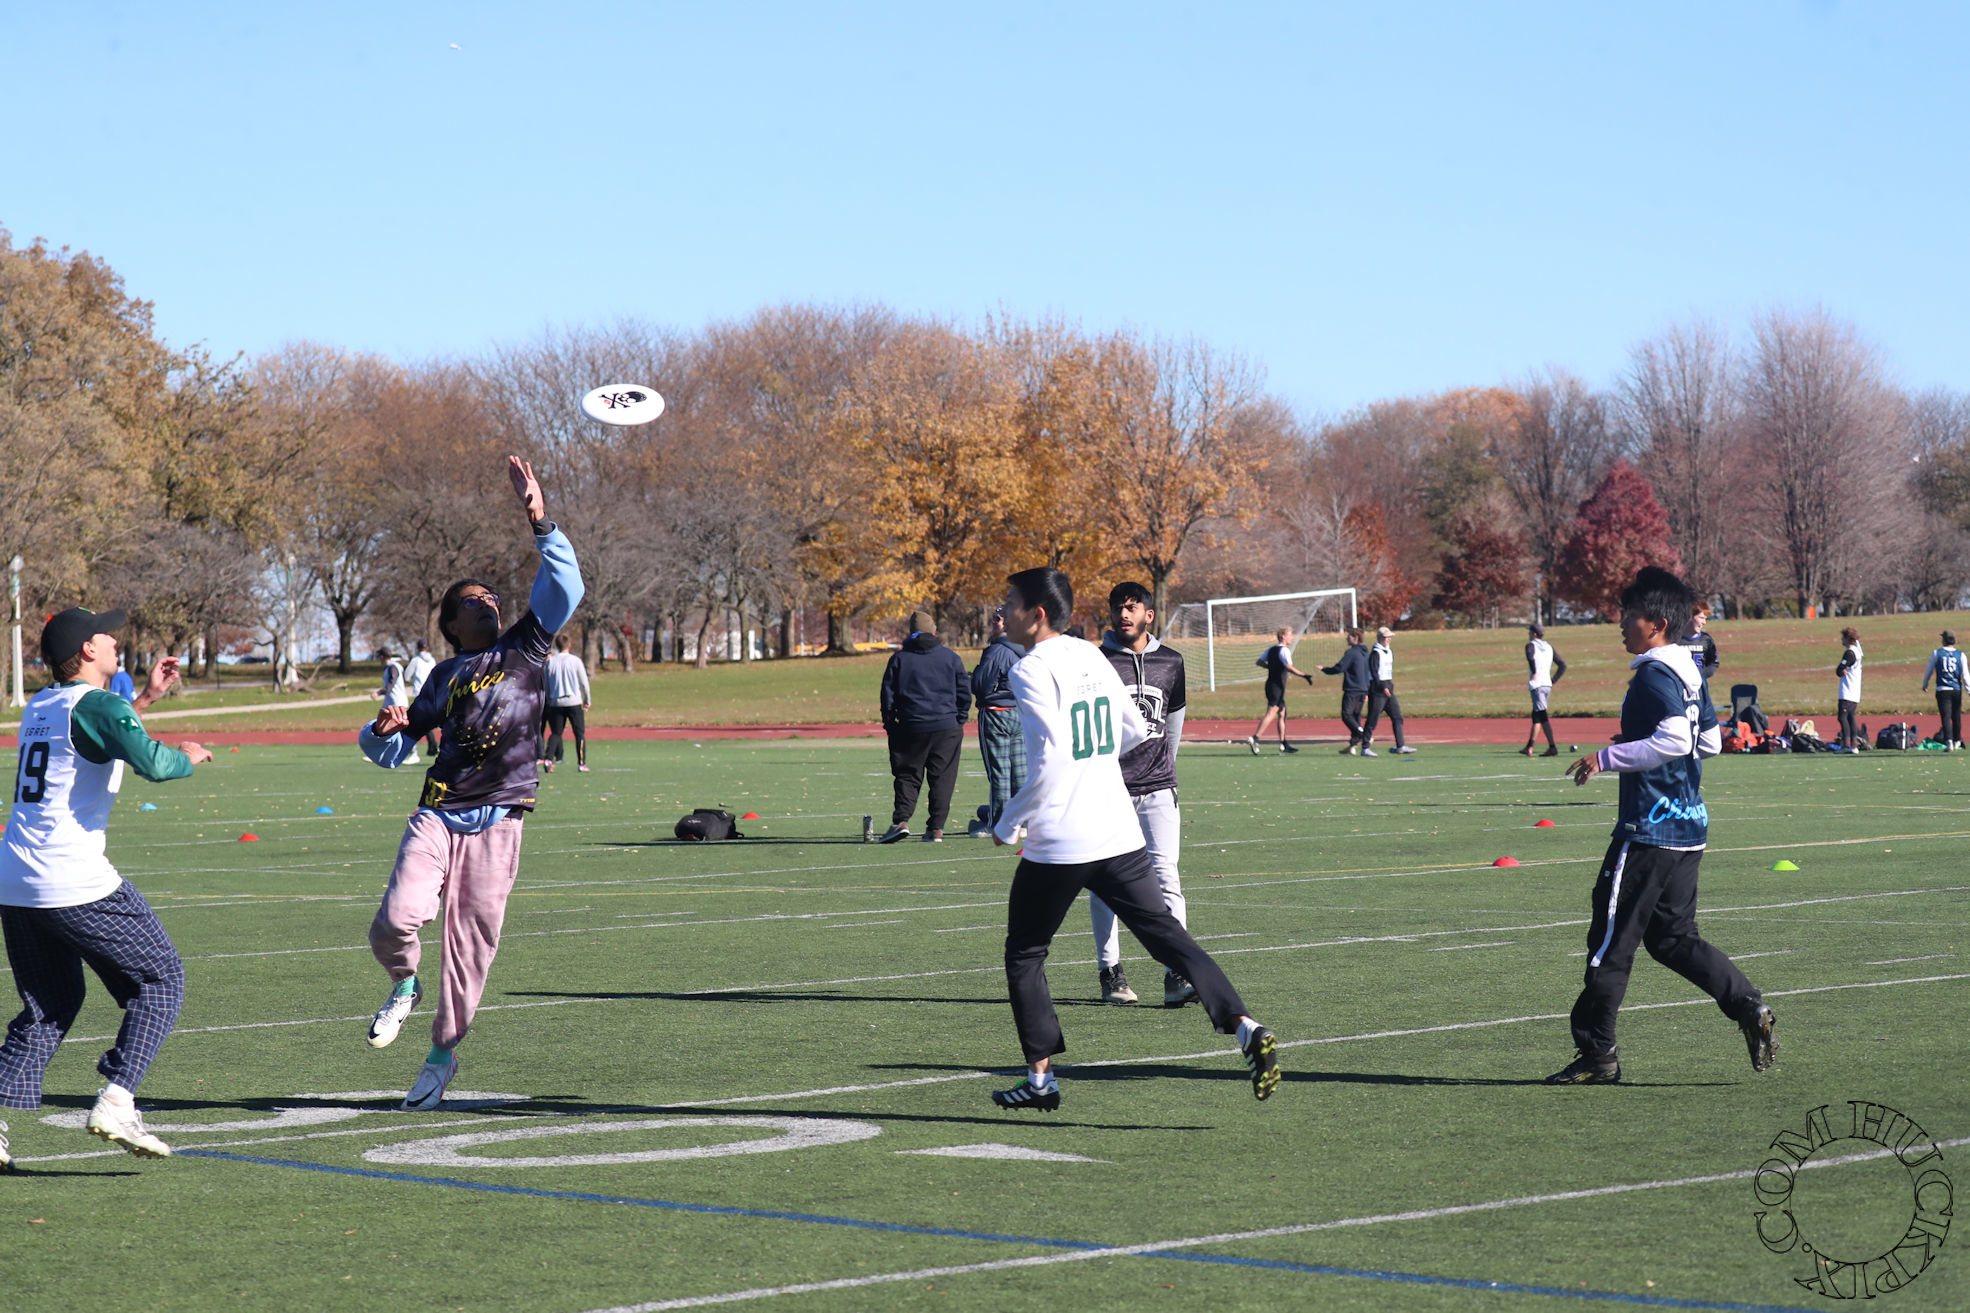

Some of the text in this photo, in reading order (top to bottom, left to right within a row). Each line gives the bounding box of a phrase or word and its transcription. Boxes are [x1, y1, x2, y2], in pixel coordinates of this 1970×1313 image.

[446, 671, 505, 717] Juice
[24, 726, 51, 737] EGRET
[1070, 696, 1115, 761] 00
[13, 741, 50, 803] 19
